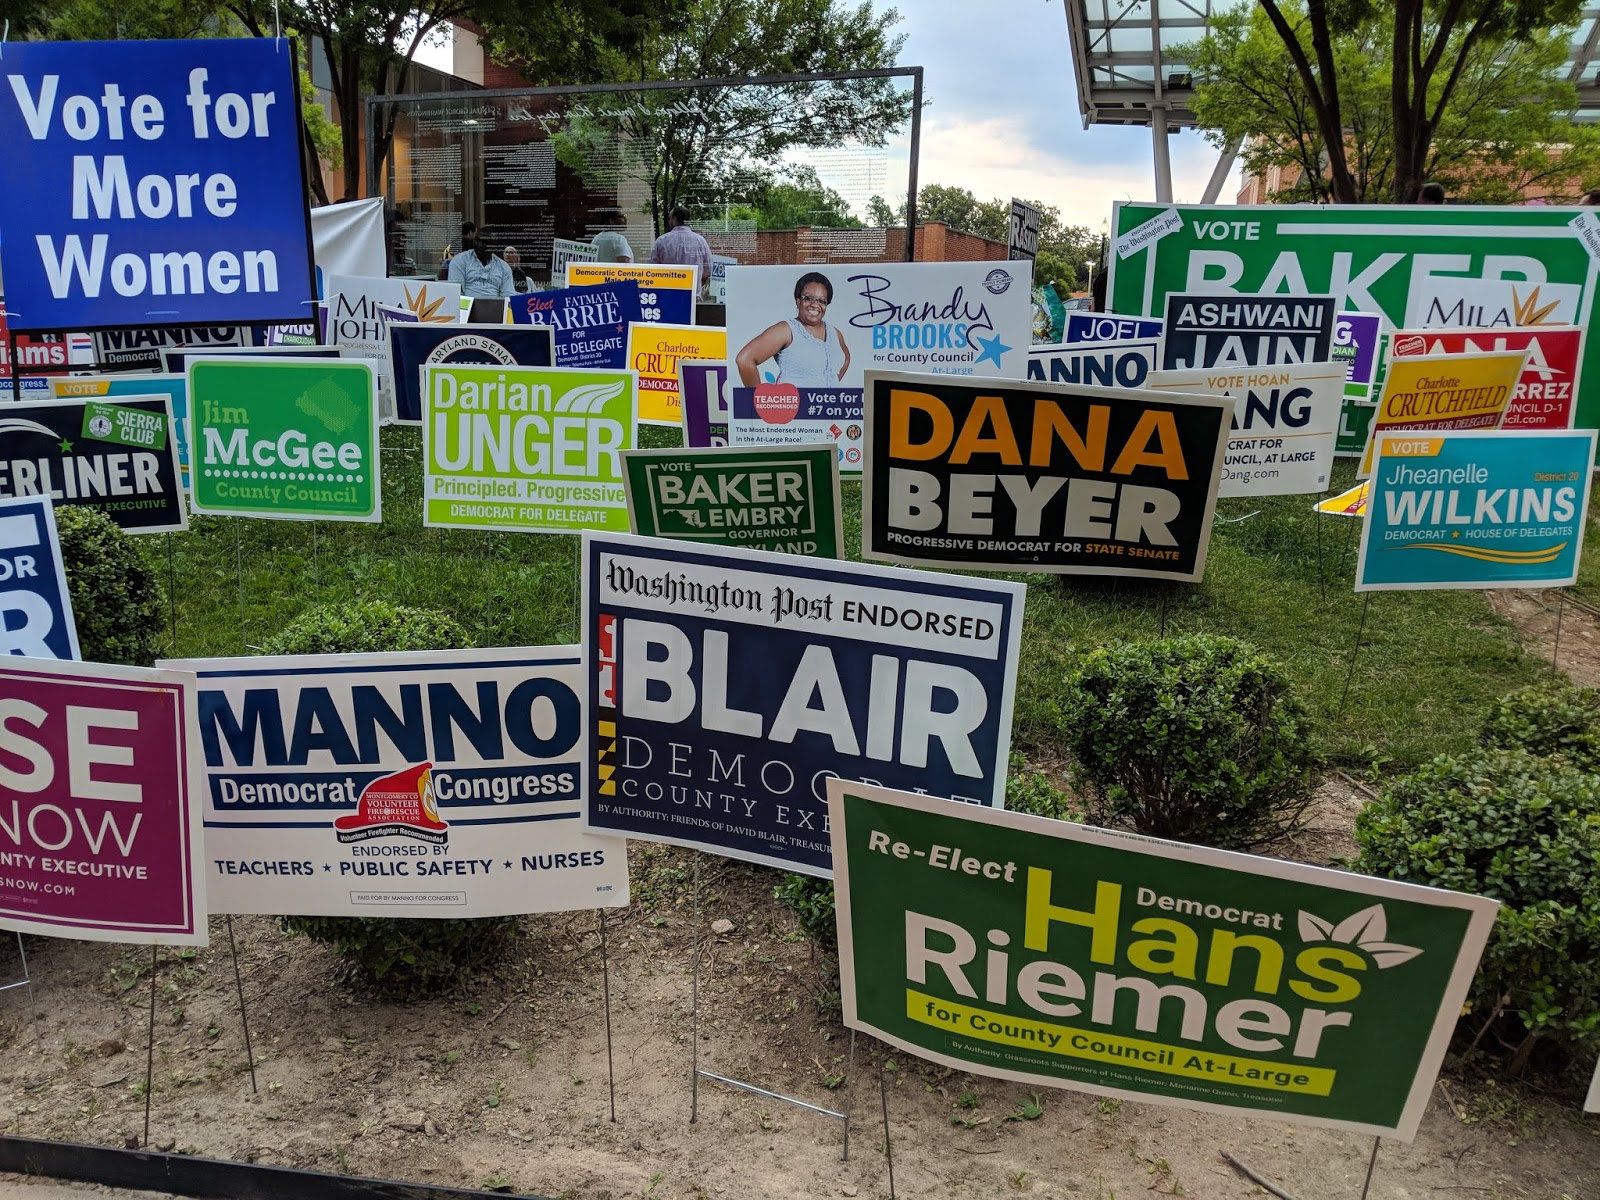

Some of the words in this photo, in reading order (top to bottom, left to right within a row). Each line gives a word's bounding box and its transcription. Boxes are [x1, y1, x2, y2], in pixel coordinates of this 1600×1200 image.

[7, 74, 165, 140] Vote
[186, 67, 276, 139] for
[72, 155, 237, 219] More
[1118, 243, 1129, 253] The
[1129, 224, 1165, 247] Washington
[1164, 215, 1180, 229] Post
[1192, 220, 1261, 240] VOTE
[35, 234, 279, 298] Women
[575, 268, 615, 277] Democratic
[617, 270, 644, 278] Central
[646, 270, 687, 279] Committee
[527, 297, 554, 313] Elect
[564, 291, 618, 308] FATMATA
[847, 274, 994, 330] Brandy
[1426, 296, 1511, 328] MILA
[528, 301, 623, 332] BARRIE
[1176, 303, 1324, 327] ASHWANI
[571, 337, 623, 354] DELEGATE
[572, 330, 586, 339] FOR
[872, 322, 968, 349] BROOKS
[108, 351, 159, 364] Democrat
[557, 355, 579, 363] Democrat
[656, 341, 700, 354] Charlotte
[873, 354, 885, 362] for
[887, 352, 927, 364] County
[930, 352, 974, 362] Council
[1175, 334, 1317, 370] JAIN
[63, 384, 98, 394] VOTE
[434, 372, 551, 412] Darian
[1207, 376, 1244, 388] VOTE
[1247, 374, 1290, 386] HOAN
[1416, 376, 1460, 390] Charlotte
[755, 395, 798, 404] TEACHER
[808, 392, 838, 403] Vote
[840, 392, 858, 403] for
[1387, 385, 1508, 418] CRUTCHFIELD
[1543, 403, 1563, 413] D-1
[116, 410, 163, 432] SIERRA
[202, 400, 249, 426] Jim
[808, 405, 824, 416] #7
[826, 407, 843, 416] on
[888, 388, 1190, 480] DANA
[1437, 418, 1454, 431] FOR
[1455, 414, 1496, 429] DELEGATE
[121, 426, 155, 445] CLUB
[434, 412, 625, 478] UNGER
[1259, 439, 1283, 449] FOR
[202, 427, 363, 470] McGee
[1264, 454, 1279, 464] AT
[1280, 452, 1316, 463] LARGE
[1391, 441, 1430, 454] VOTE
[660, 462, 692, 472] VOTE
[1386, 463, 1488, 485] Jheanelle
[1534, 472, 1567, 482] District
[1568, 472, 1578, 481] 20
[215, 482, 281, 503] County
[284, 484, 358, 503] Council
[434, 477, 521, 500] Principled.
[527, 481, 625, 502] Progressive
[657, 472, 805, 505] BAKER
[106, 499, 167, 512] EXECUTIVE
[450, 504, 515, 519] DEMOCRAT
[519, 507, 543, 520] FOR
[547, 509, 607, 524] DELEGATE
[708, 505, 804, 527] EMBRY
[887, 466, 1182, 547] BEYER
[1384, 486, 1576, 526] WILKINS
[728, 528, 798, 539] GOVERNOR
[1384, 529, 1447, 540] DEMOCRAT
[1465, 528, 1502, 539] HOUSE
[1503, 528, 1518, 538] OF
[1520, 526, 1573, 538] DELEGATES
[887, 532, 974, 550] PROGRESSIVE
[977, 540, 1050, 553] DEMOCRAT
[1054, 542, 1082, 553] FOR
[1085, 543, 1124, 555] STATE
[1128, 547, 1180, 561] SENATE
[606, 558, 764, 614] Washington
[770, 585, 834, 625] Post
[842, 600, 995, 641] ENDORSED
[621, 616, 989, 780] BLAIR
[197, 676, 582, 768] MANNO
[219, 776, 356, 804] Democrat
[434, 771, 575, 803] Congress
[621, 779, 758, 819] COUNTY
[367, 800, 419, 808] VOLUNTEER
[340, 831, 367, 842] Volunteer
[367, 828, 399, 837] Firefighter
[400, 828, 444, 843] Recommended
[598, 804, 611, 813] BY
[612, 806, 670, 822] AUTHORITY:
[671, 814, 710, 829] FRIENDS
[711, 822, 725, 831] OF
[726, 824, 756, 838] DAVID
[758, 831, 788, 845] BLAIR,
[352, 845, 428, 857] ENDORSED
[433, 845, 450, 856] BY
[868, 829, 1018, 883] Re-Elect
[42, 857, 148, 880] EXECUTIVE
[214, 859, 314, 876] TEACHERS
[340, 861, 410, 877] PUBLIC
[416, 859, 494, 876] SAFETY
[521, 850, 606, 872] NURSES
[1136, 886, 1284, 931] Democrat
[1024, 865, 1368, 1004] Hans
[904, 909, 1353, 1060] Riemer
[925, 1001, 962, 1025] for
[969, 1013, 1062, 1049] County
[1071, 1035, 1175, 1066] Council
[1182, 1055, 1310, 1087] At-Large
[952, 1041, 963, 1049] By
[964, 1044, 1001, 1059] Authority:
[1005, 1053, 1050, 1067] Grassroots
[1051, 1061, 1098, 1075] Supporters
[1099, 1069, 1109, 1077] of
[1110, 1071, 1133, 1081] Hans
[1169, 1082, 1210, 1094] Marianne
